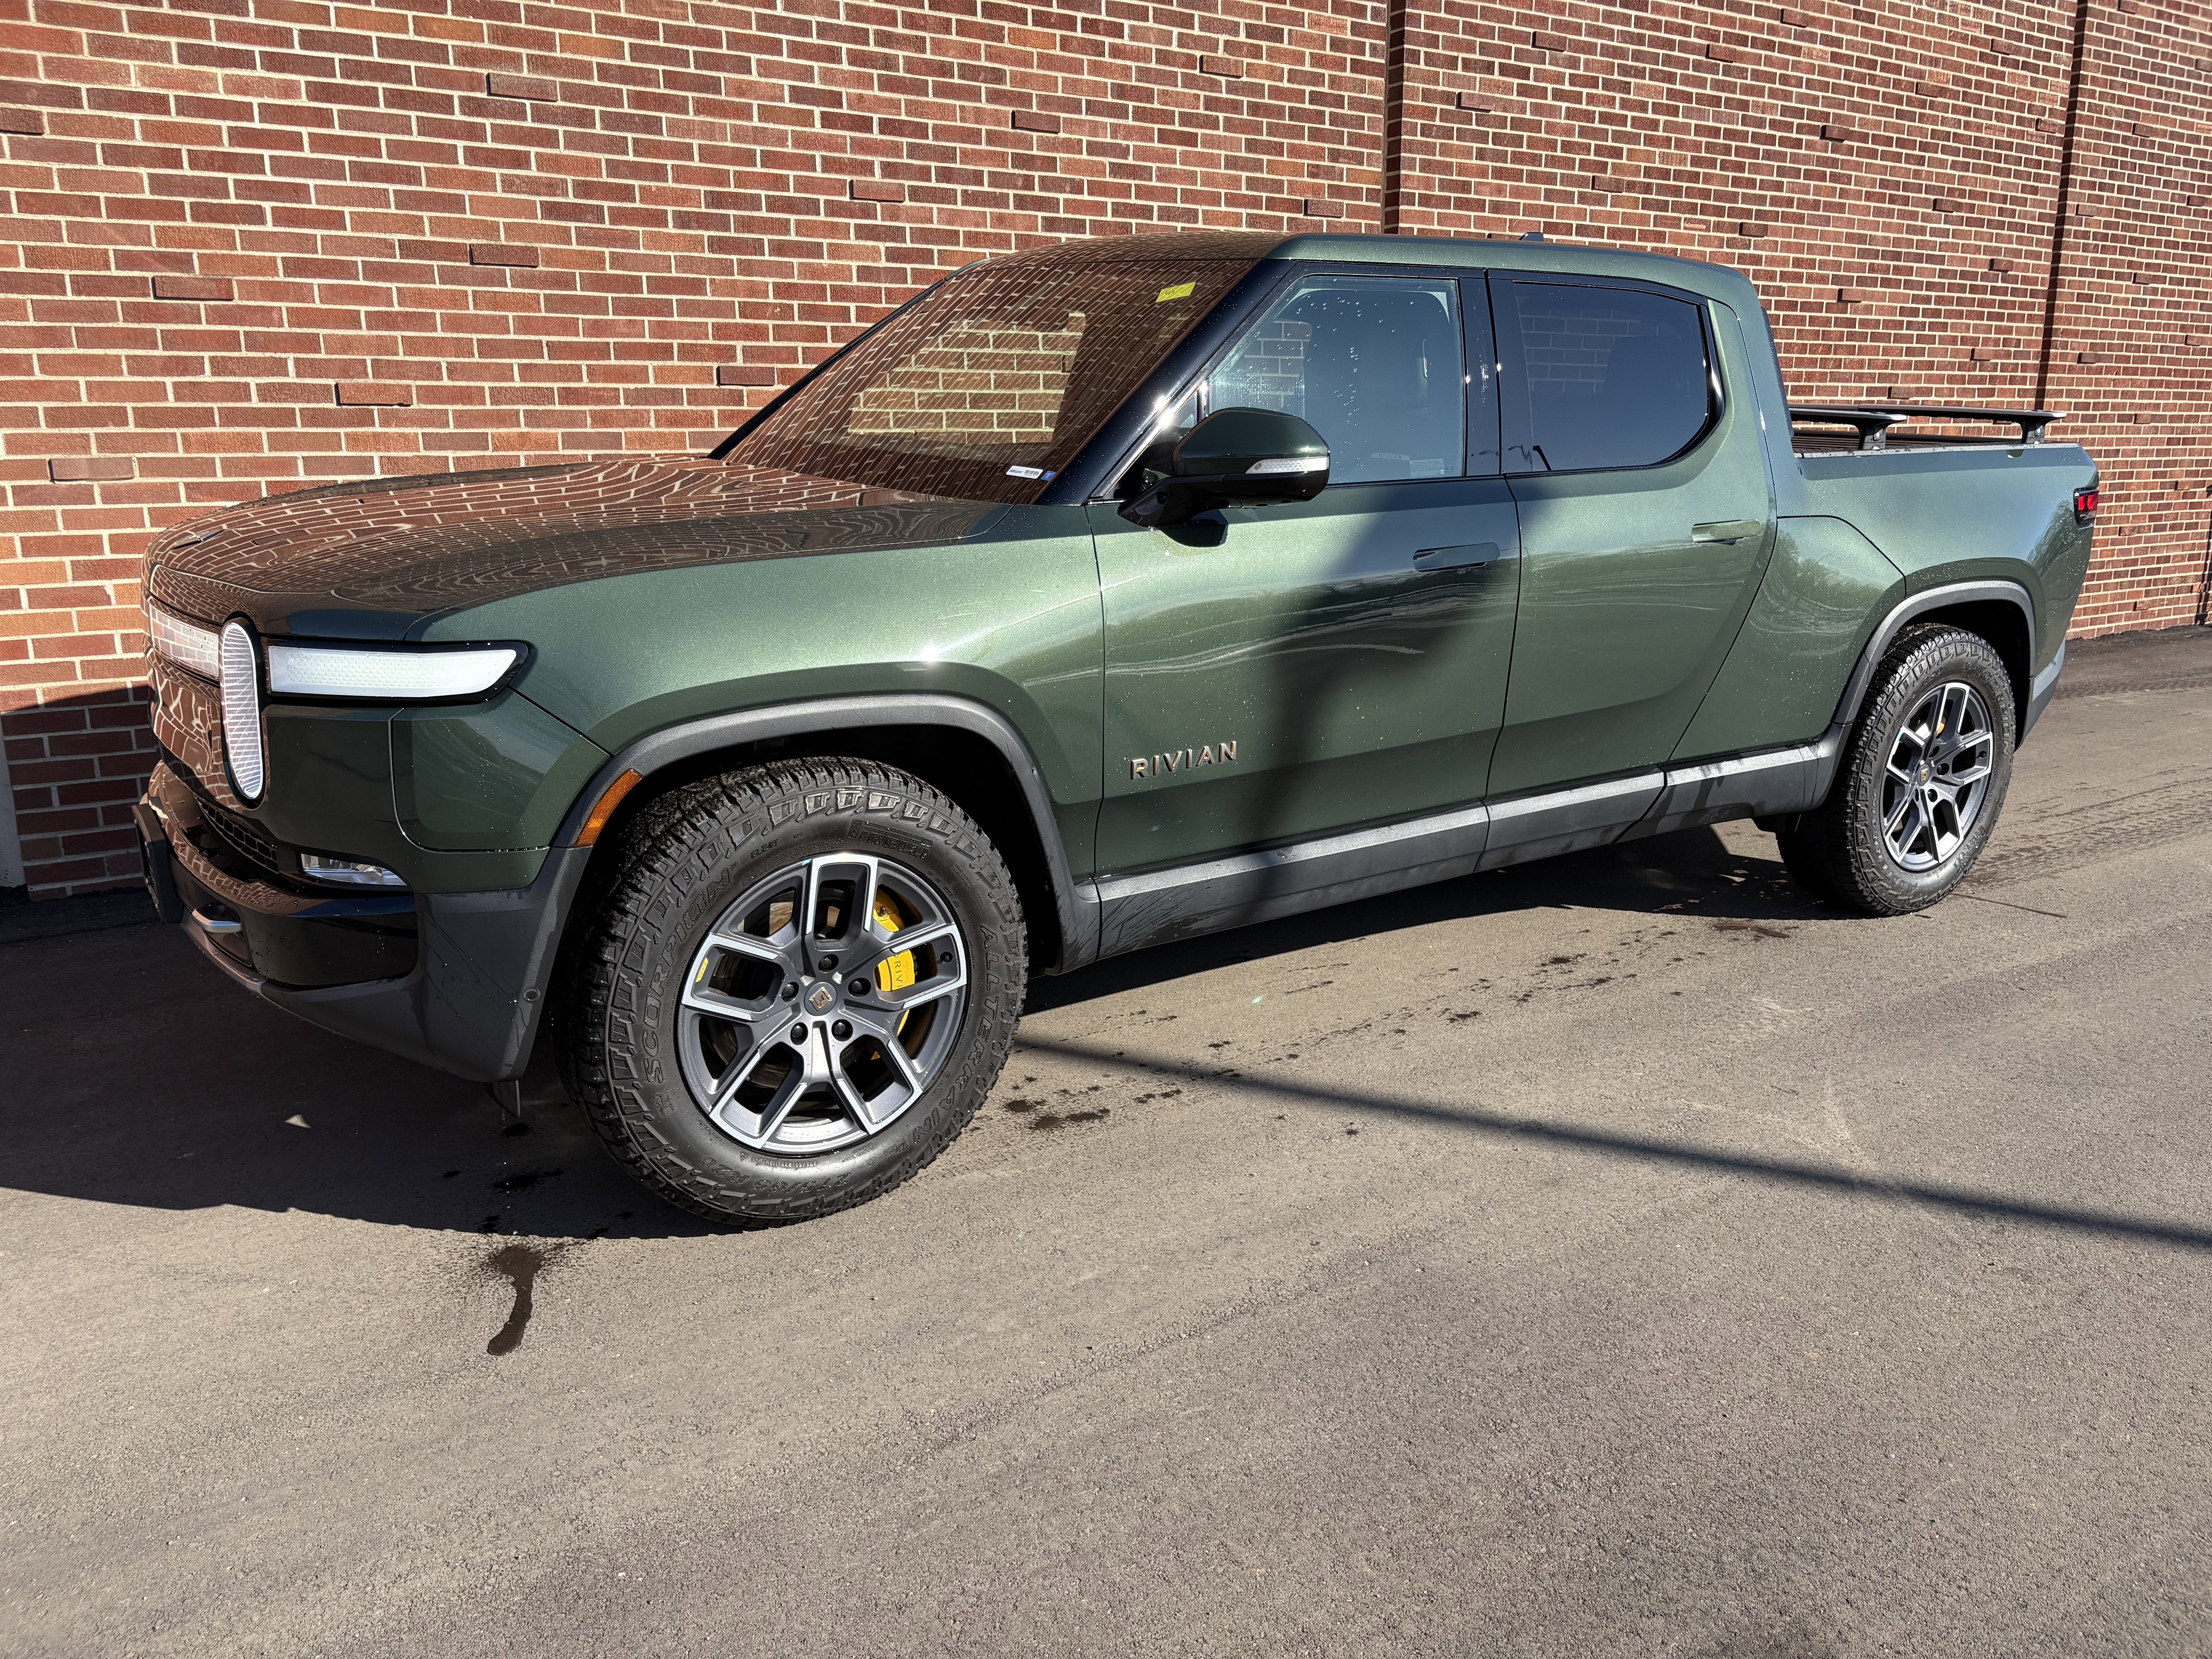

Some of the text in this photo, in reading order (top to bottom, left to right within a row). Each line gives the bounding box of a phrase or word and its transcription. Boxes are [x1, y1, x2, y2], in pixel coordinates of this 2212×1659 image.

[1973, 664, 2010, 757] SCORPION
[1130, 741, 1237, 780] RIVIAN
[846, 819, 933, 860] PIRELLI
[642, 867, 730, 1083] SCORPION
[895, 960, 903, 988] RIVI
[980, 924, 999, 991] ALL
[913, 996, 999, 1144] TERRAIN
